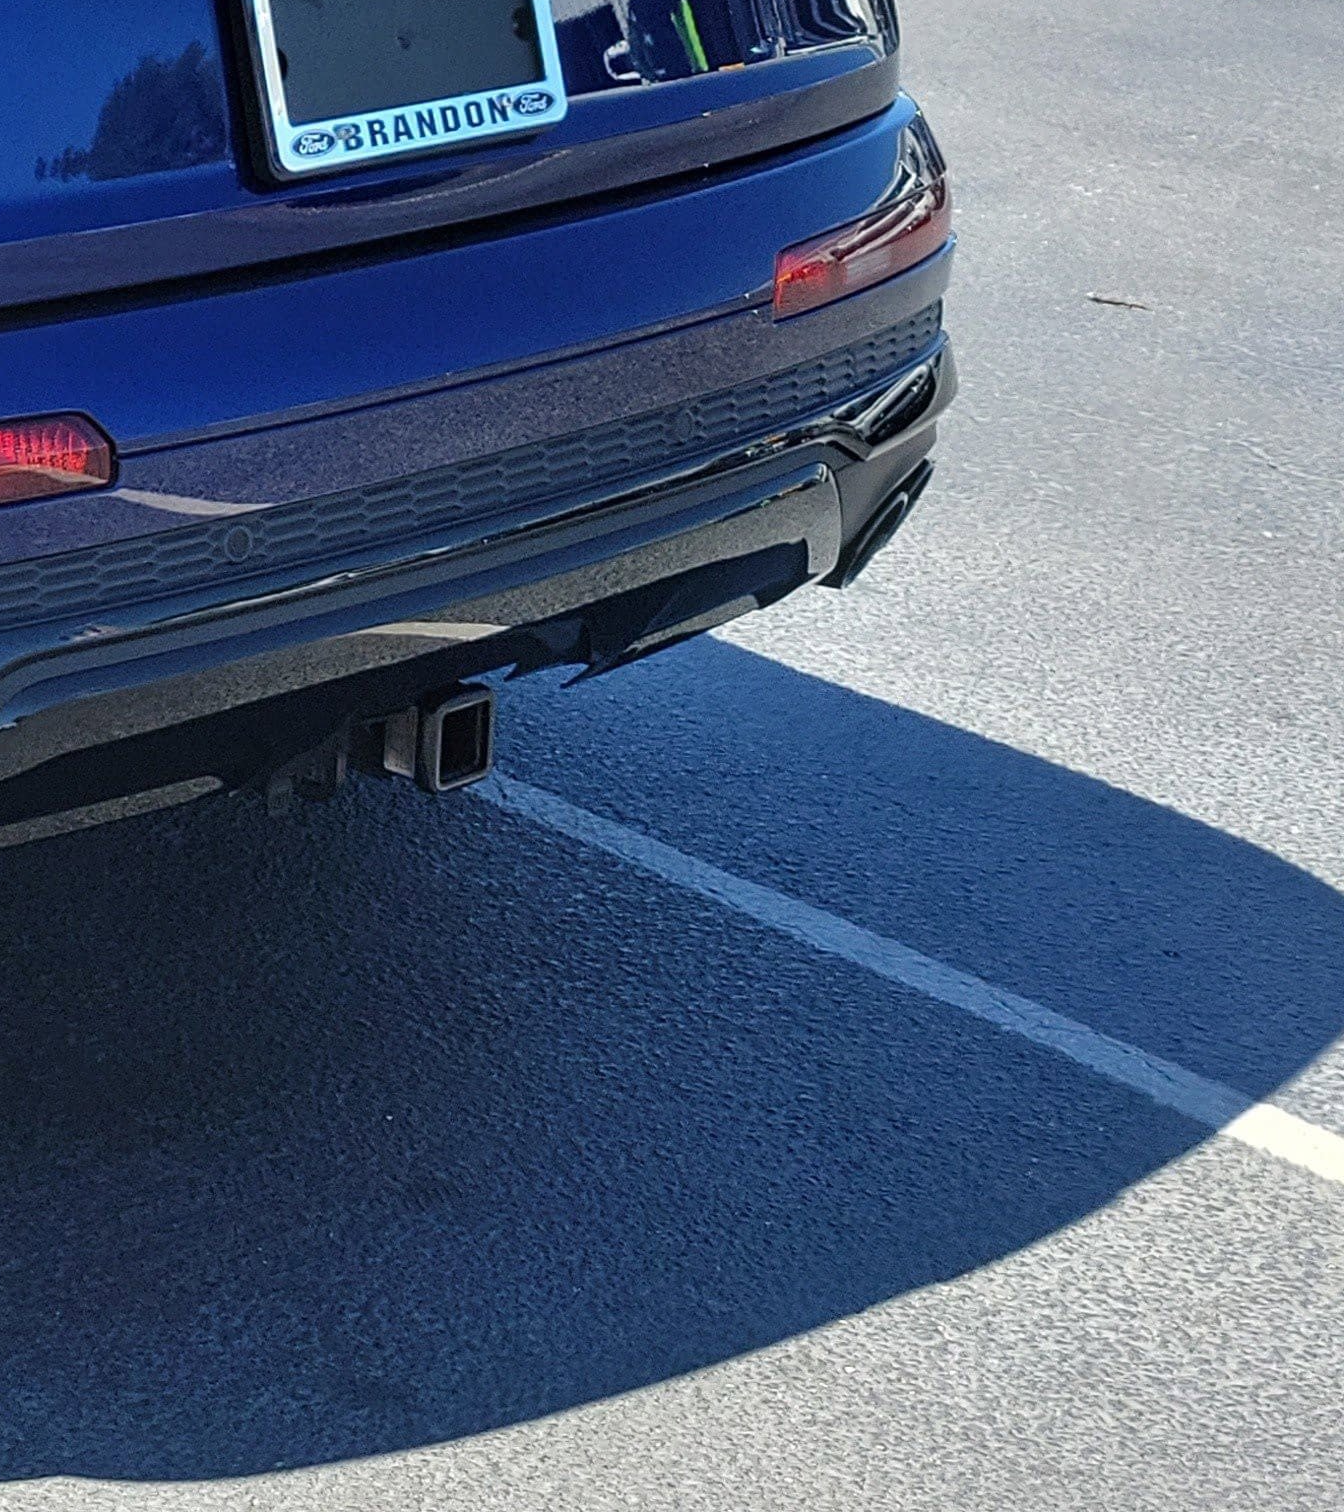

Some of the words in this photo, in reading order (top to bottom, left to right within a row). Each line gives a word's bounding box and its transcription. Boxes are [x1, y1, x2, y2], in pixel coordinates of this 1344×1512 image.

[297, 130, 330, 155] Ford
[333, 92, 514, 152] BRANDON
[517, 91, 551, 115] Ford
